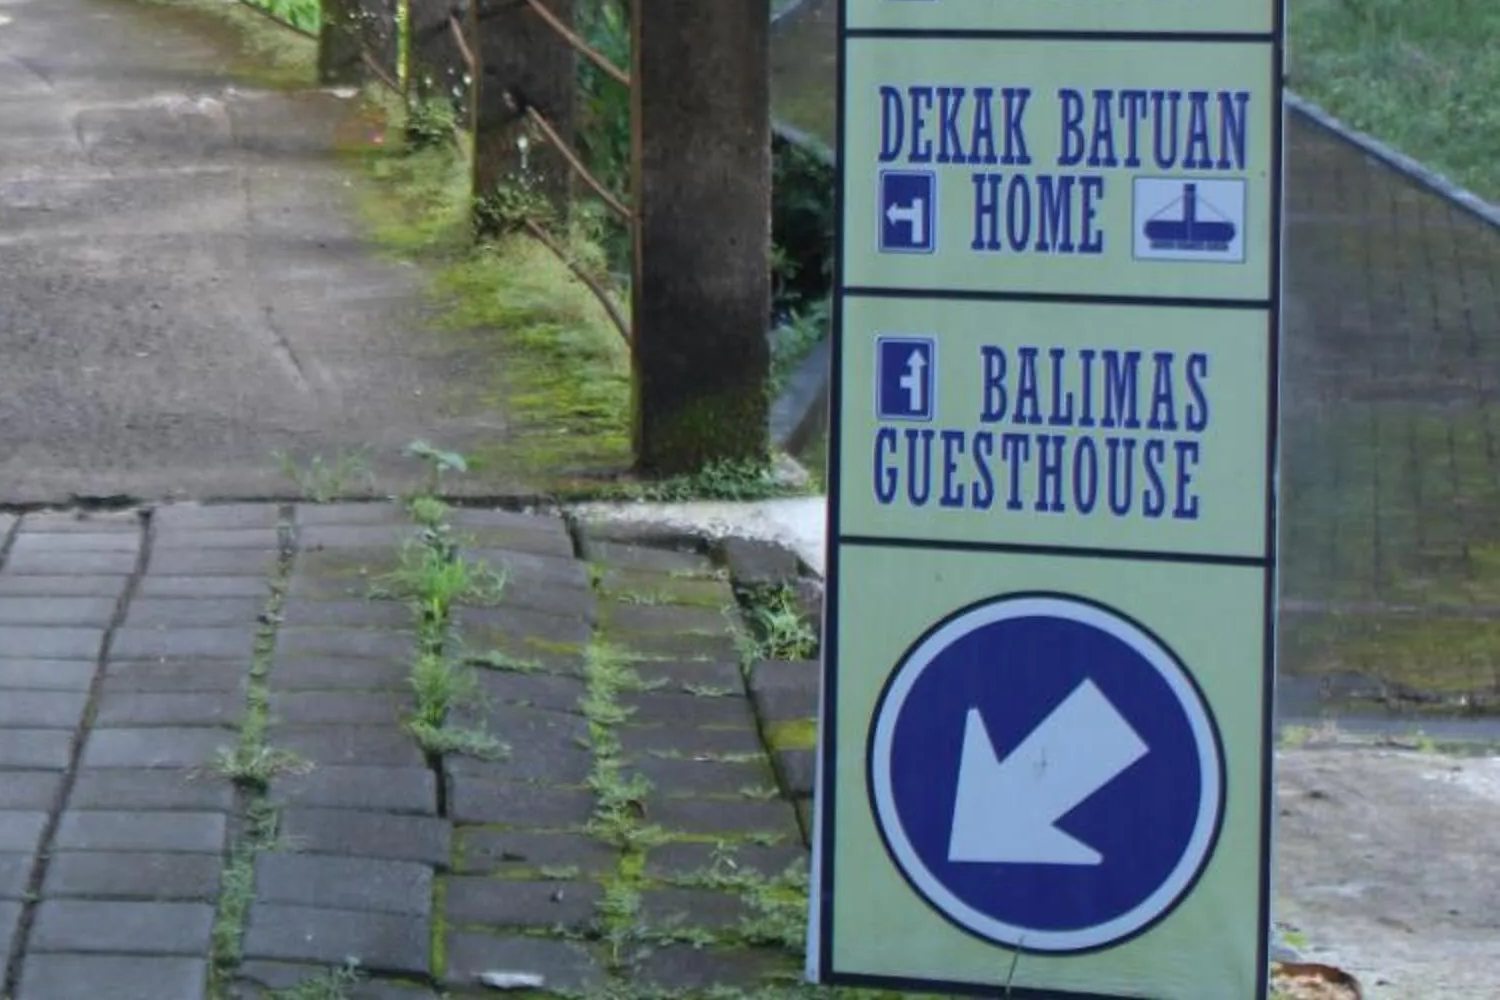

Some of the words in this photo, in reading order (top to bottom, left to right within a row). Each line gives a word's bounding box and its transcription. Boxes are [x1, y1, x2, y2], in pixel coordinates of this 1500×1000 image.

[878, 85, 1032, 166] DEKAK
[1057, 88, 1250, 171] BATUAN
[971, 173, 1104, 254] HOME
[979, 345, 1209, 433] BALIMAS
[873, 426, 1200, 520] GUESTHOUSE
